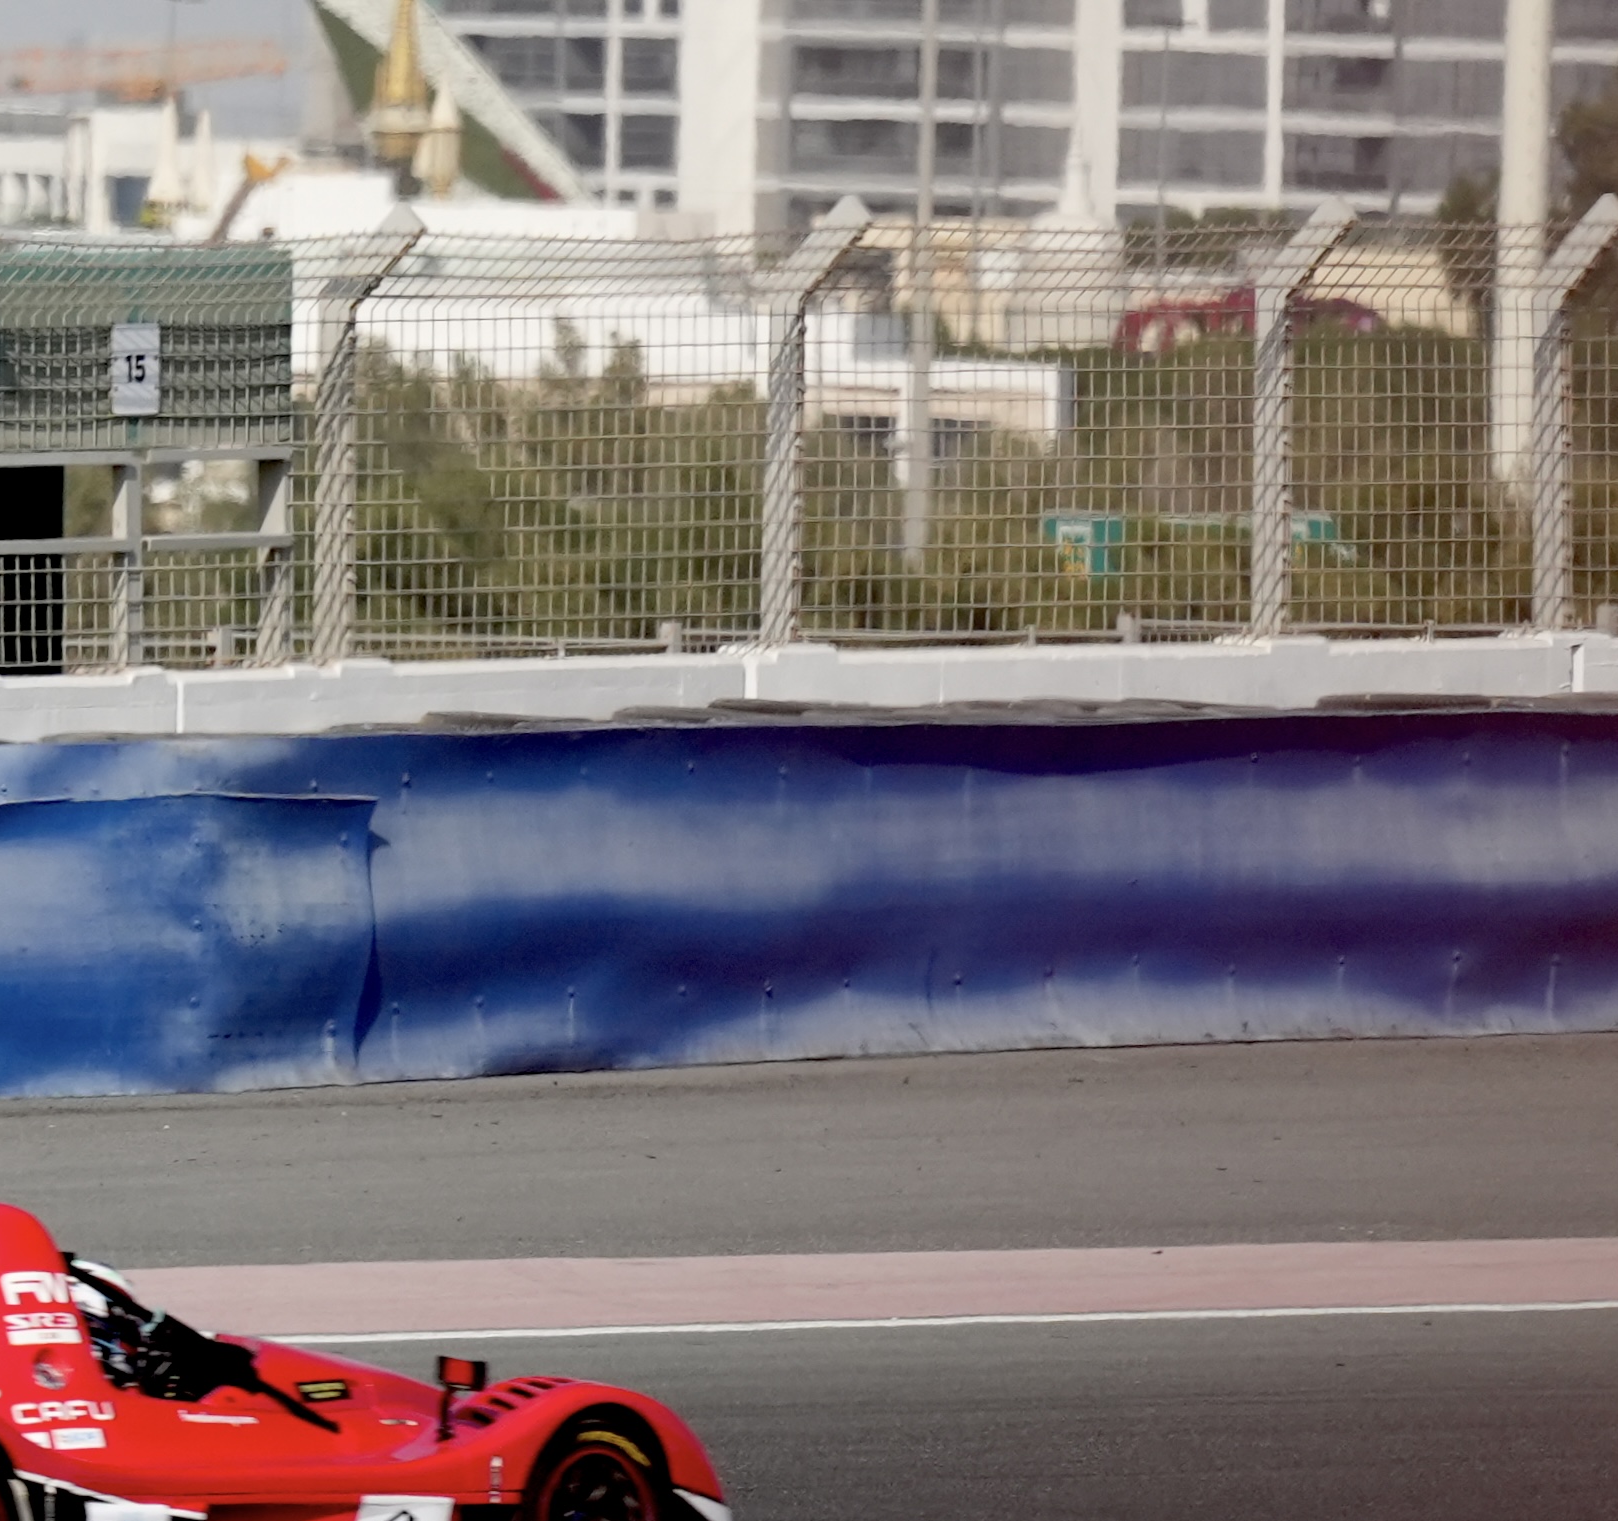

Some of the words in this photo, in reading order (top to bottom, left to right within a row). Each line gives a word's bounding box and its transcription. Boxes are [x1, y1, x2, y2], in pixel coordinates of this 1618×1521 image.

[126, 354, 146, 383] 15
[2, 1312, 78, 1330] SR3
[11, 1400, 116, 1424] CAFU
